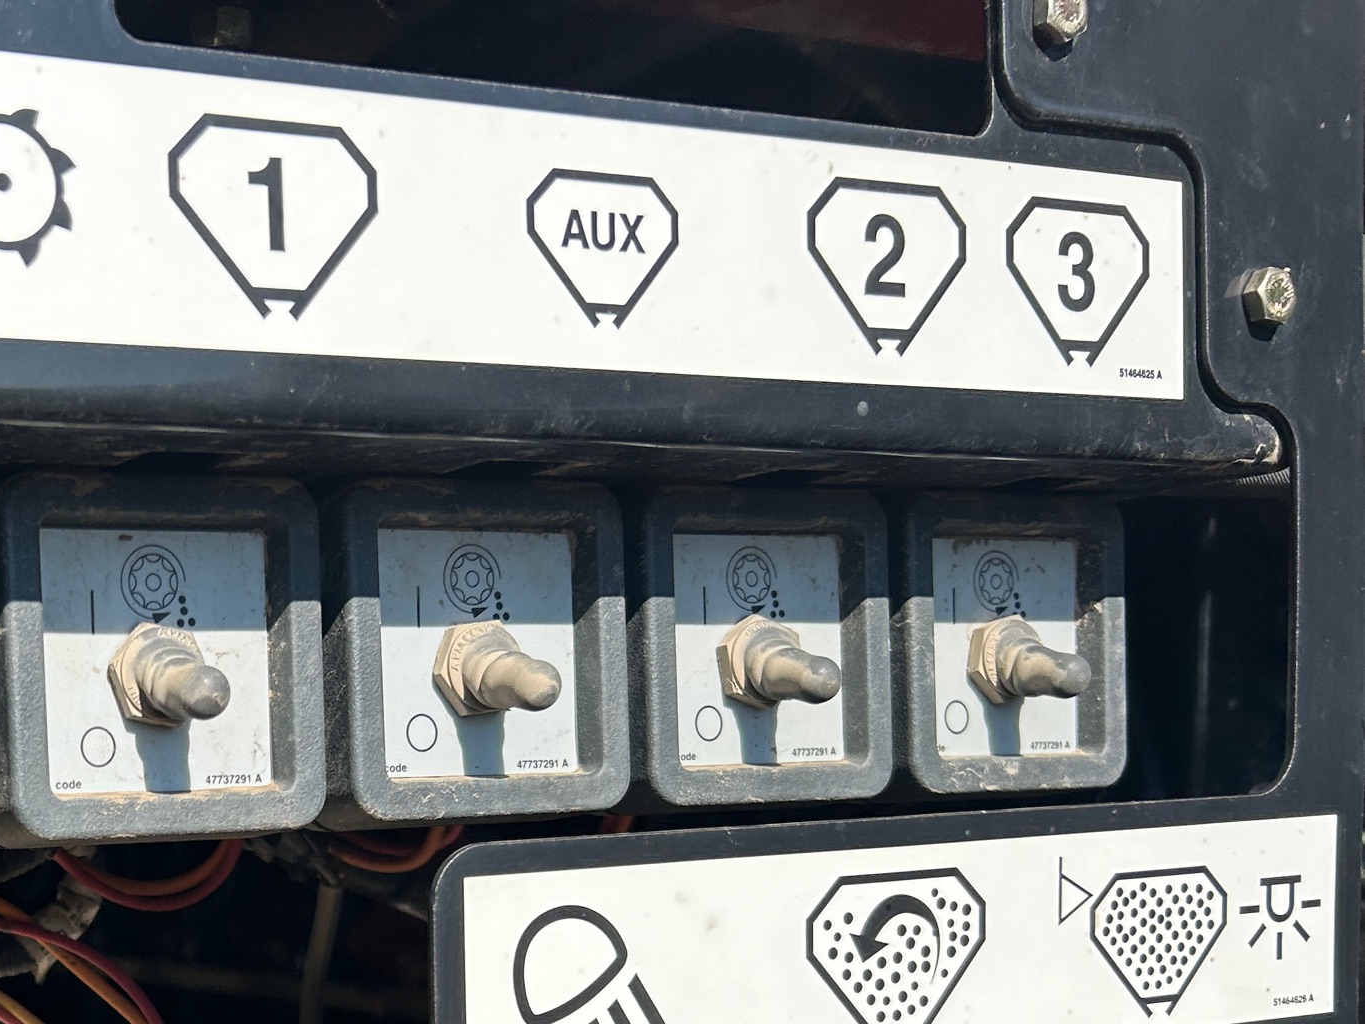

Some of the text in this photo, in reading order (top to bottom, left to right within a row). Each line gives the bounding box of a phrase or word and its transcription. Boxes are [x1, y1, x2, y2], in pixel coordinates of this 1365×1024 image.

[248, 157, 285, 252] 1
[561, 209, 645, 254] AUX
[864, 213, 906, 298] 2
[1058, 231, 1095, 312] 3
[1156, 369, 1163, 380] A
[1064, 740, 1071, 749] A
[679, 751, 697, 761] ode
[791, 746, 837, 757] 47737291 A
[517, 758, 569, 770] 47737291 A
[55, 780, 82, 790] code
[205, 774, 263, 785] 47737291 A
[1308, 993, 1315, 1002] A
